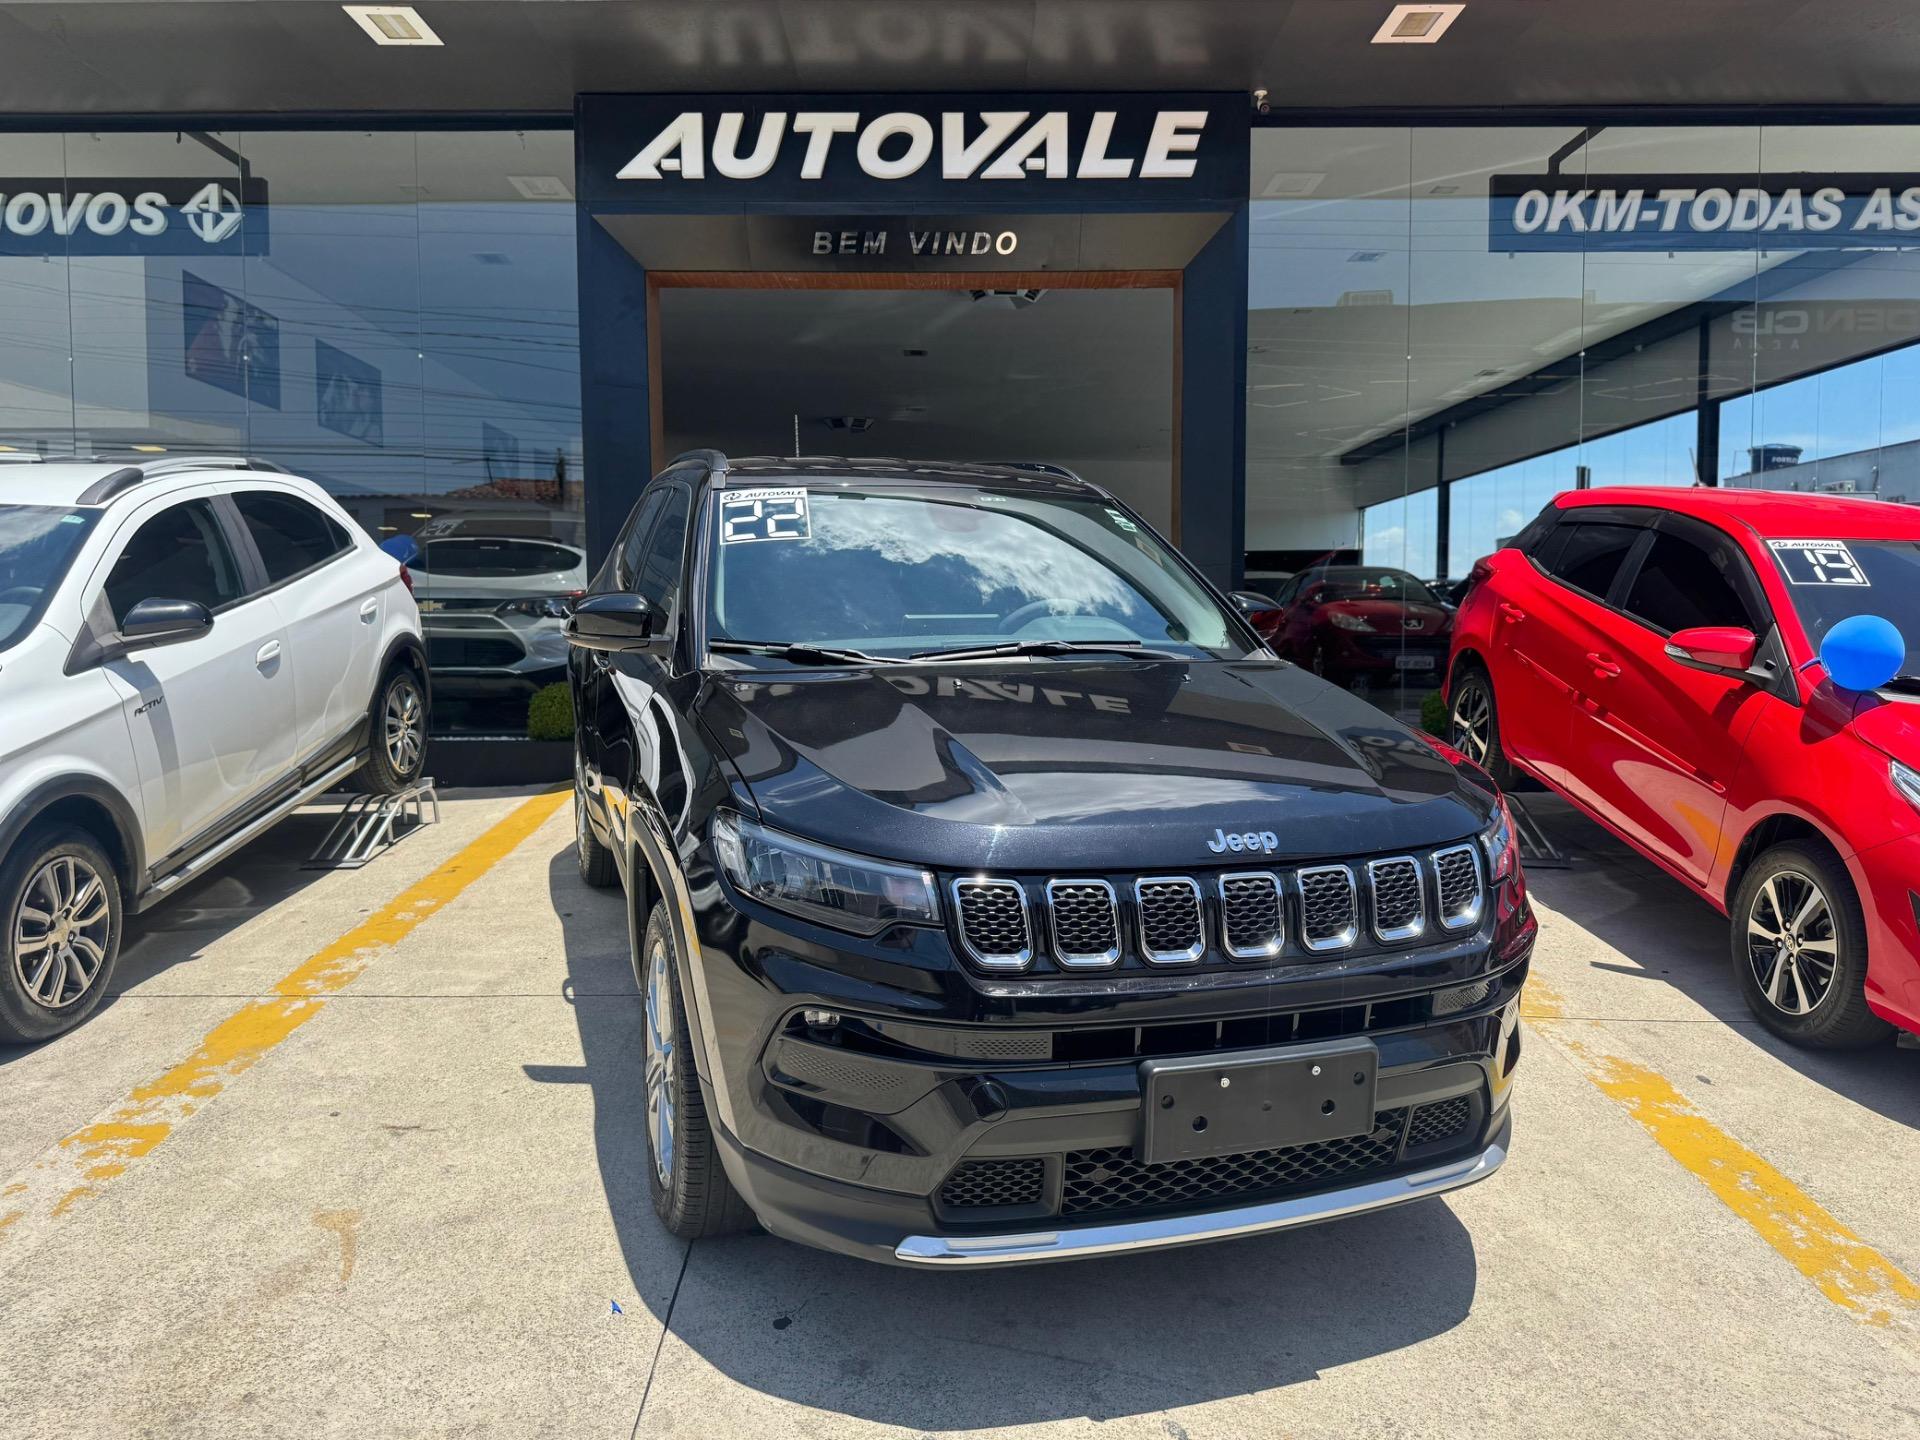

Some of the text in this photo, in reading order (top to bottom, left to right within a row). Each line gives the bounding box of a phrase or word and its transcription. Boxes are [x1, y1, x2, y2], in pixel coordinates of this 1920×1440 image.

[615, 111, 1208, 180] AUTOVALE
[0, 192, 171, 236] OVOS
[812, 231, 1018, 255] BEM VINDO
[725, 498, 804, 541] 22
[1803, 549, 1863, 584] 19
[134, 695, 164, 717] ACTIV
[1207, 829, 1279, 854] Jeep
